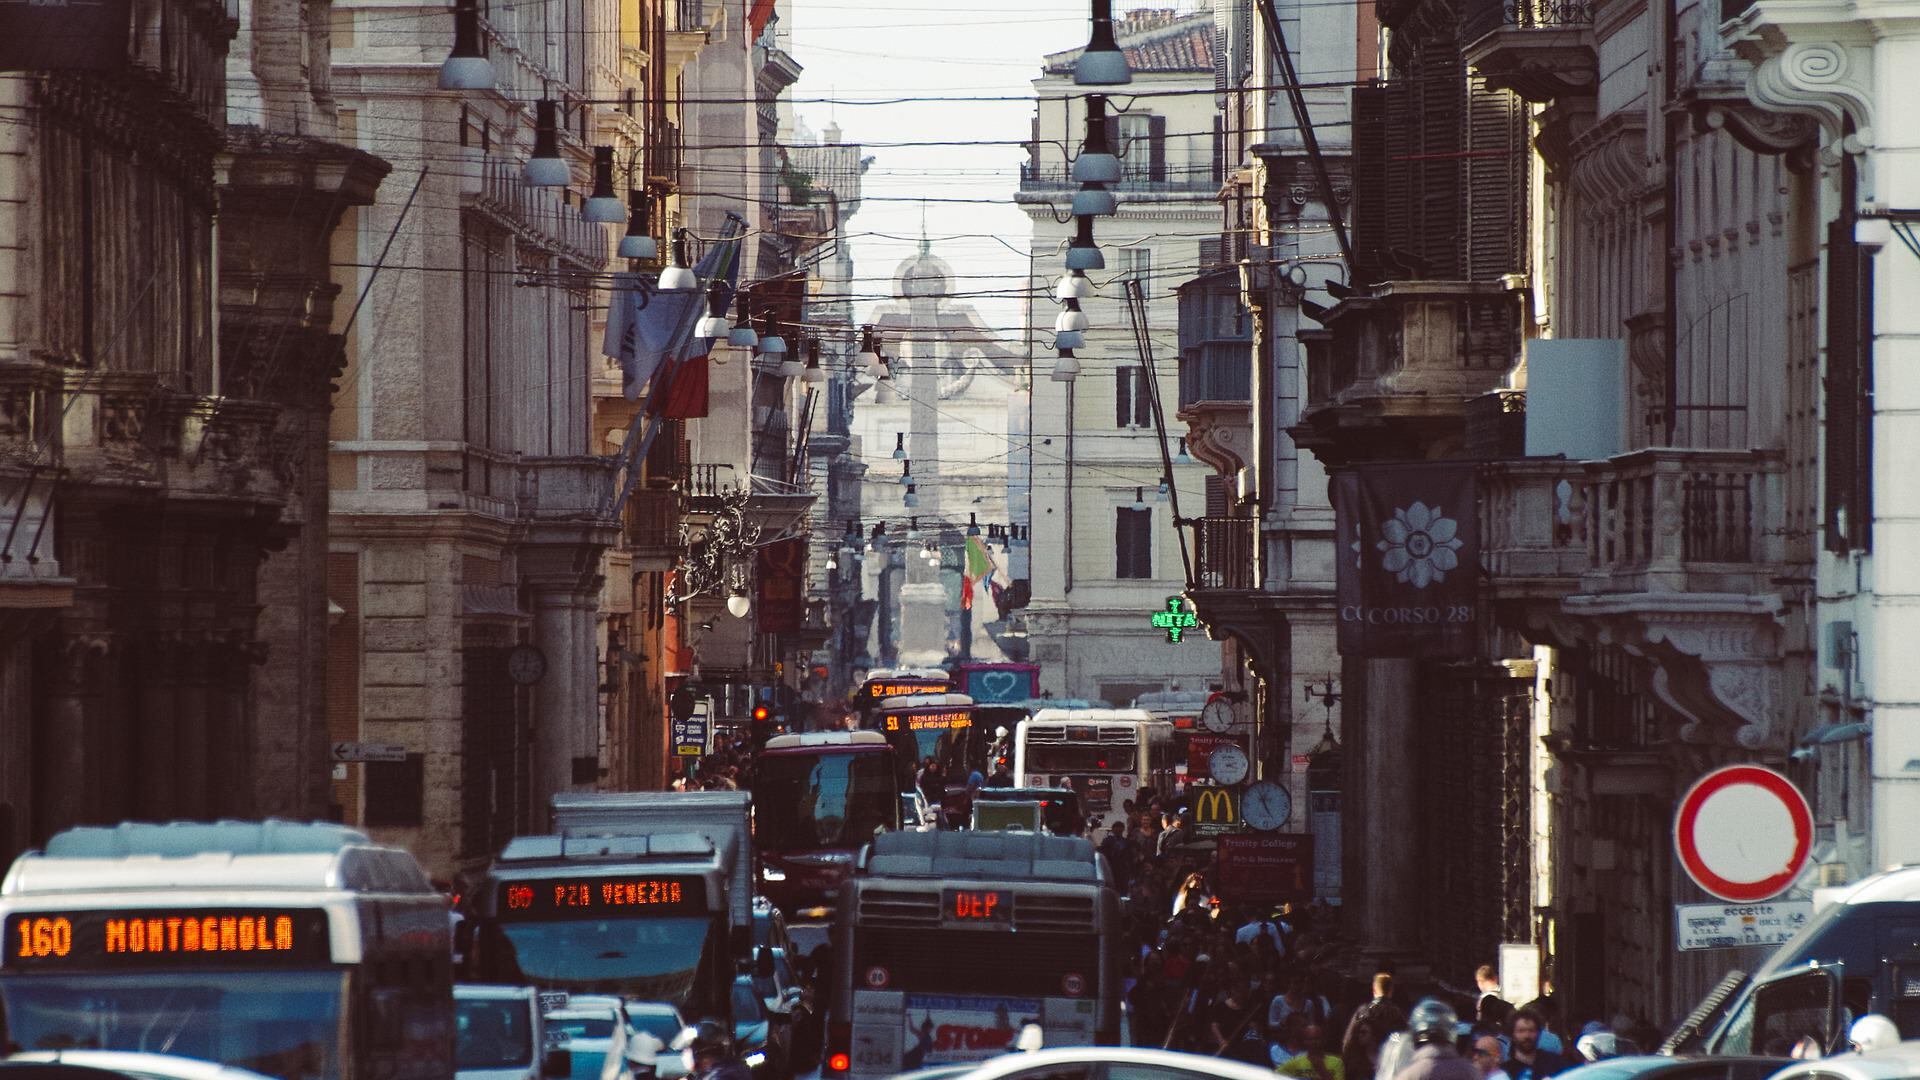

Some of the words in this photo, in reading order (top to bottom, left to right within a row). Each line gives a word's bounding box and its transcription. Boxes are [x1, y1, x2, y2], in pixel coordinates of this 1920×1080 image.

[1367, 606, 1440, 624] CORSO
[887, 716, 899, 731] 51
[1225, 839, 1258, 848] Trinity
[1261, 839, 1297, 849] College
[555, 884, 590, 906] PZA
[602, 882, 681, 905] VENEZIA
[955, 891, 998, 918] DEP
[1723, 906, 1774, 916] eccetto
[18, 918, 72, 957] 160
[106, 916, 293, 953] MONTAGNOLA
